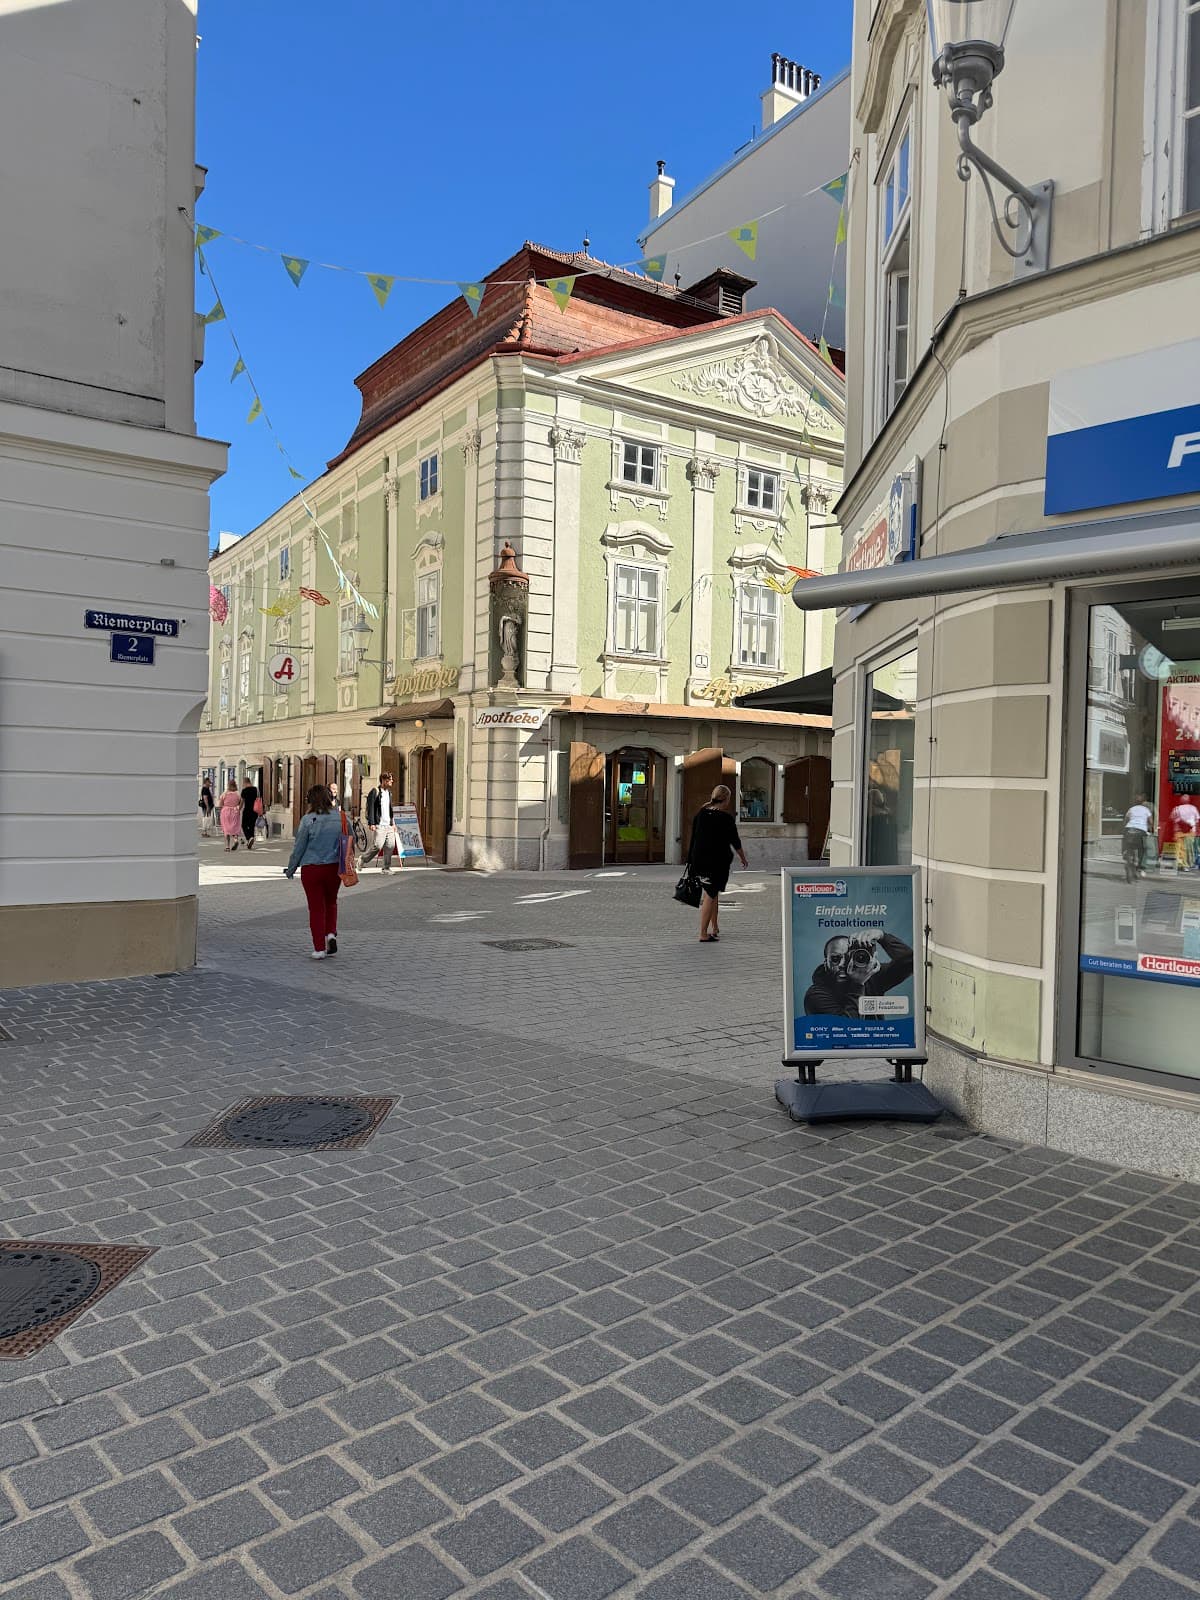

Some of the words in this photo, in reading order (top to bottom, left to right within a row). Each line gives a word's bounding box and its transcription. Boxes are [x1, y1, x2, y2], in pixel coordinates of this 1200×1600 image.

[93, 613, 173, 635] Riemerplatz
[128, 638, 138, 652] 2
[274, 657, 294, 680] A
[391, 666, 458, 697] Apotheke
[476, 711, 540, 725] Apotheke
[816, 906, 852, 917] Einfach
[854, 905, 887, 915] MEHR
[819, 918, 884, 927] Fotoaktionen
